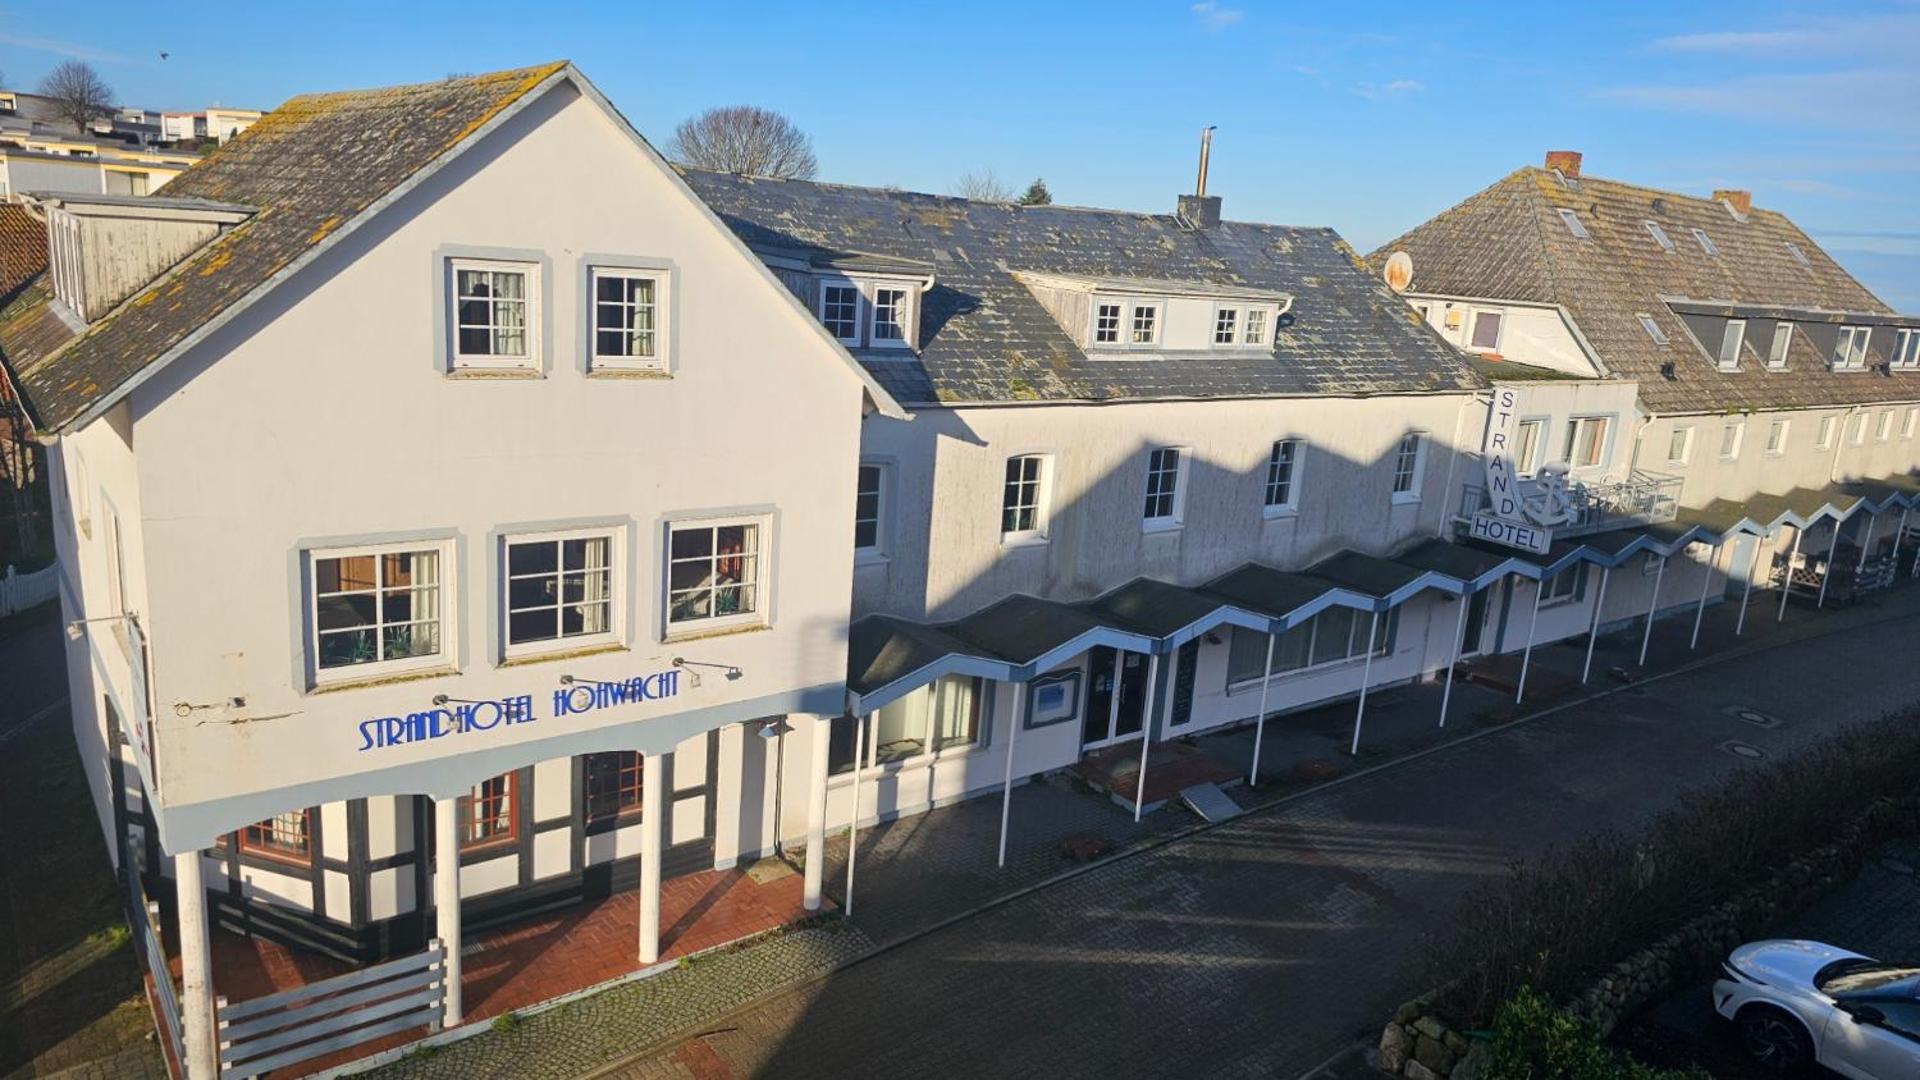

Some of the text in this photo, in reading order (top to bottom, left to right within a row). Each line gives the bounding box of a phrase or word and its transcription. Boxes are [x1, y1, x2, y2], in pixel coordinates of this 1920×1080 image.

[1490, 391, 1514, 515] STRAND
[1473, 517, 1540, 549] HOTEL
[553, 669, 681, 717] HOHWACHT
